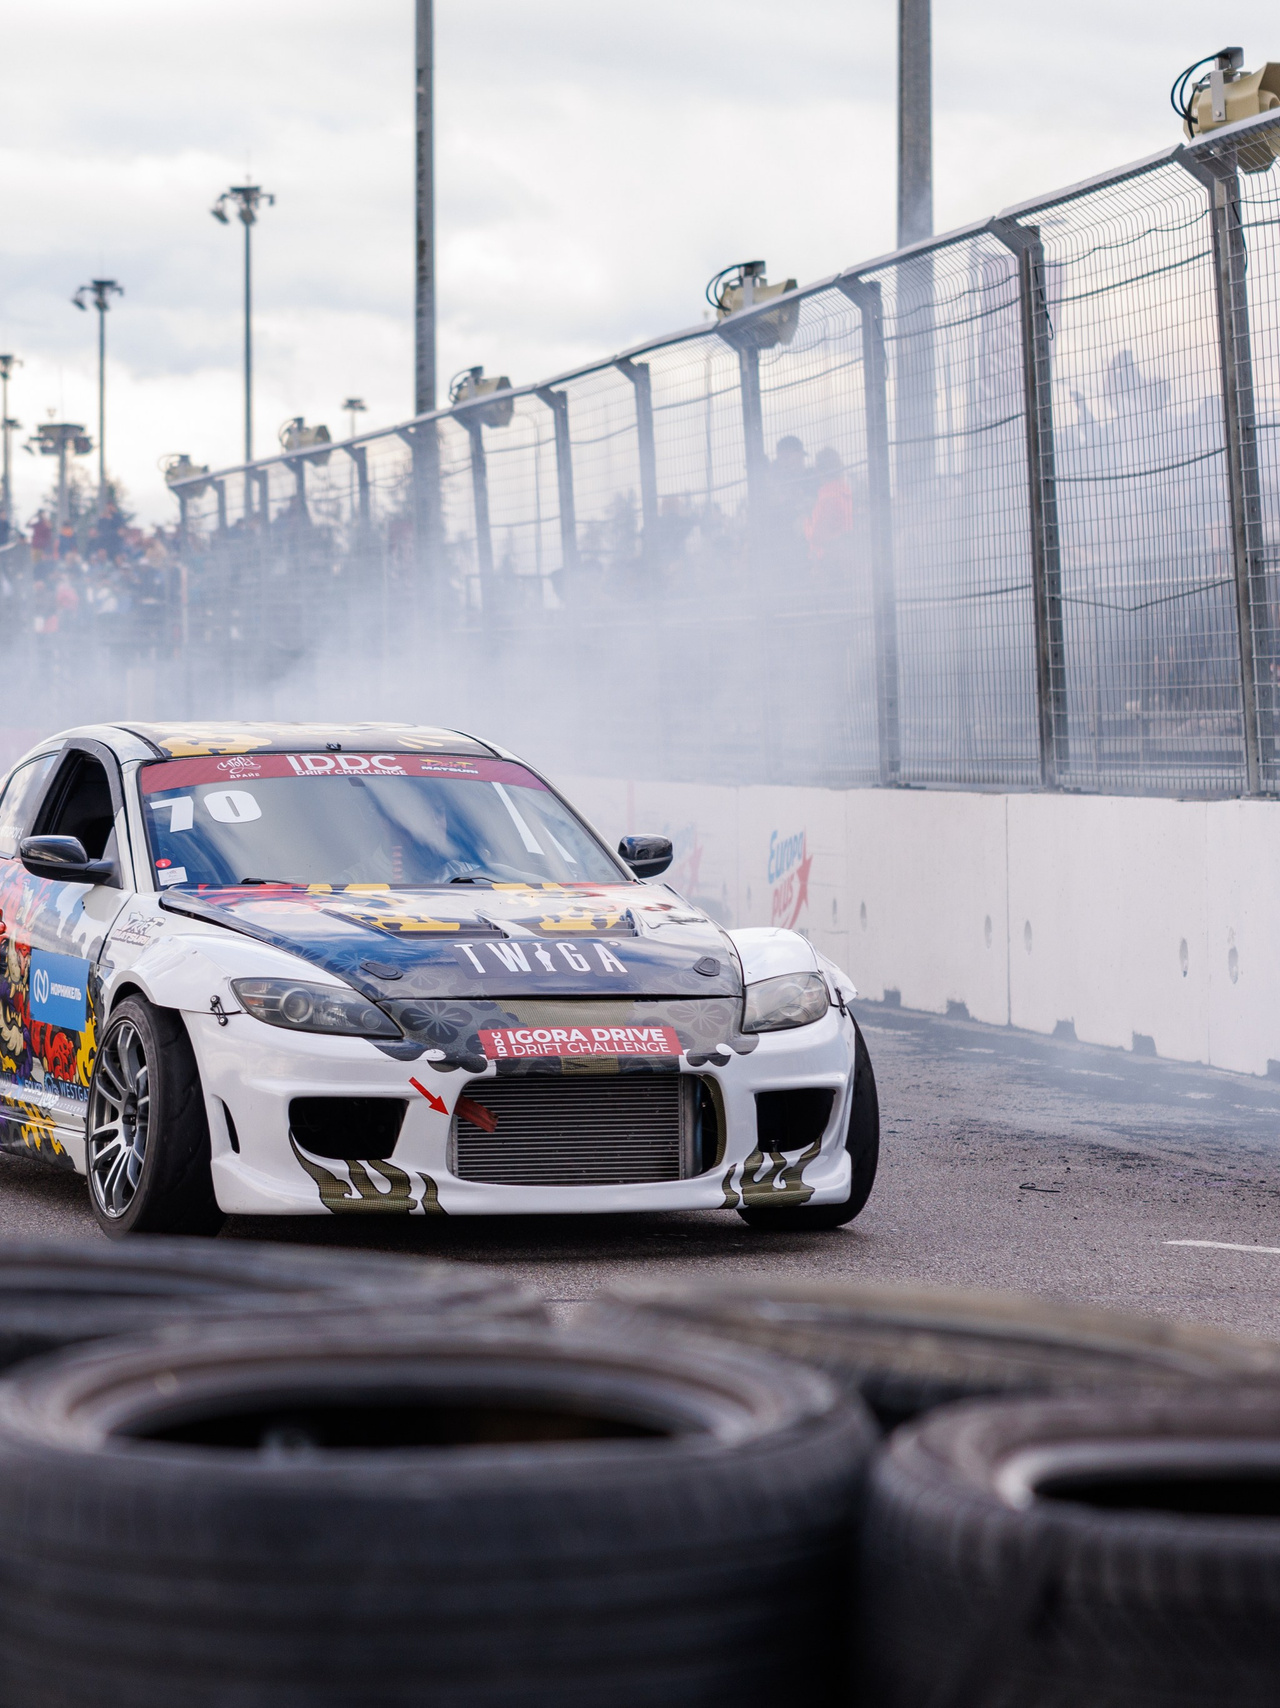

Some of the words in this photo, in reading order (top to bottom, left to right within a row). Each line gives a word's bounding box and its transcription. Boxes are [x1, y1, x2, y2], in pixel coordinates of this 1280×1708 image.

[286, 755, 403, 771] IDDC
[421, 766, 479, 774] MATSURI
[491, 1031, 508, 1057] IDDC
[506, 1028, 585, 1045] IGORA
[590, 1028, 667, 1042] DRIVE
[511, 1042, 568, 1056] DRIFT
[572, 1041, 672, 1053] CHALLENGE
